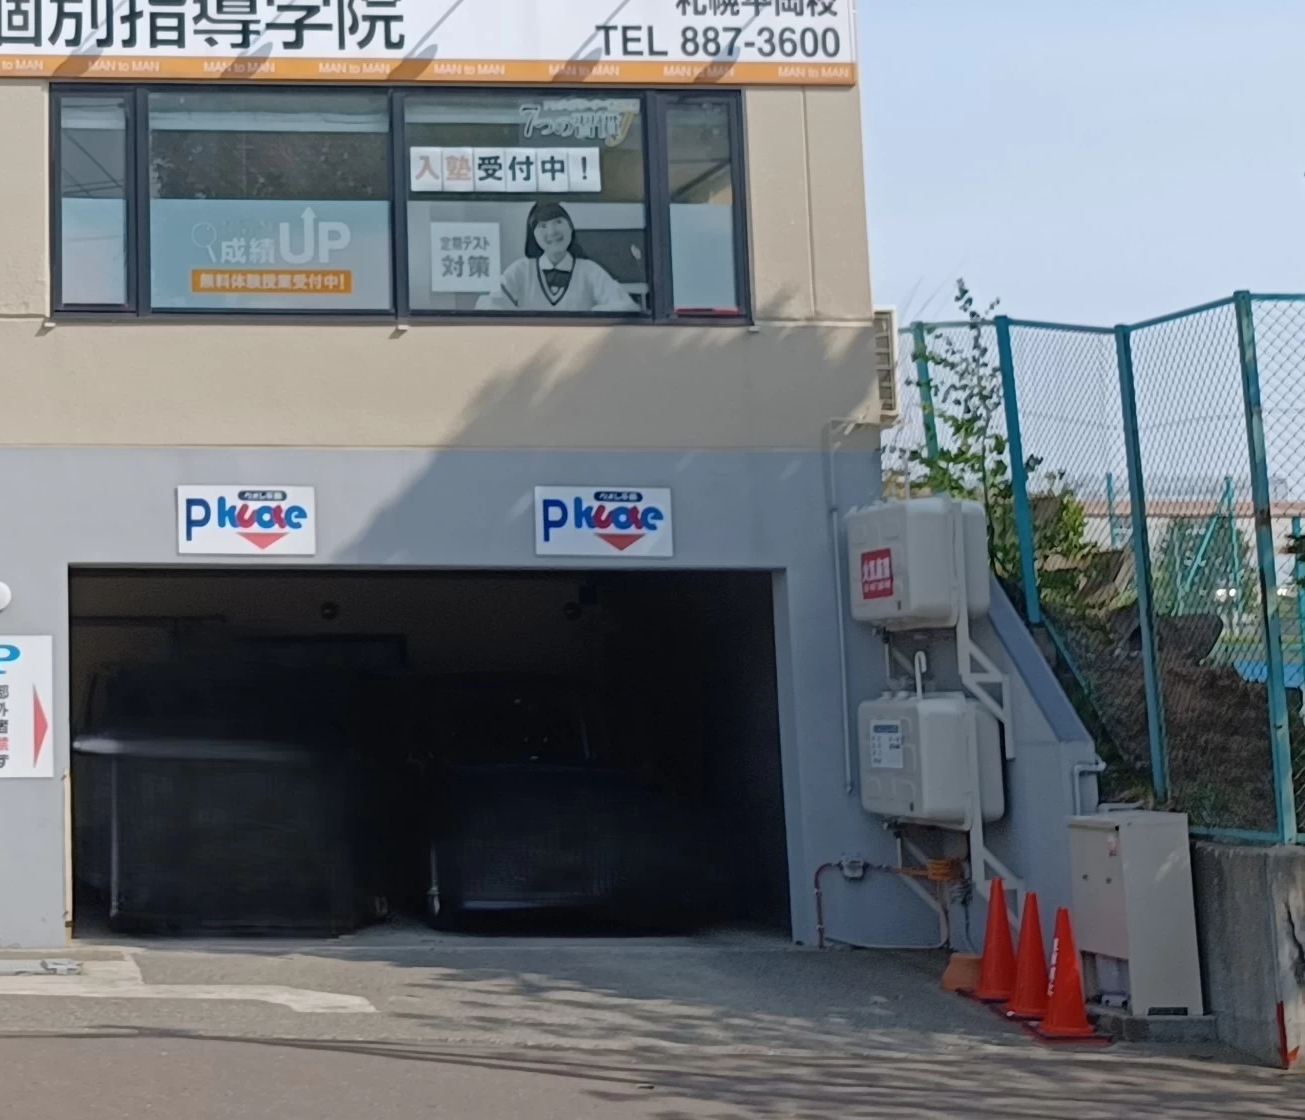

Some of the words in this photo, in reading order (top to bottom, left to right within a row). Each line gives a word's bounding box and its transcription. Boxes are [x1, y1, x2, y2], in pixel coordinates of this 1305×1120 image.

[595, 25, 668, 56] TEL
[680, 26, 840, 58] 887-3600
[16, 59, 43, 70] MAN
[88, 60, 116, 71] MAN
[132, 60, 159, 71] MAN
[204, 61, 231, 73] MAN
[247, 61, 275, 73] MAN
[319, 62, 346, 74] MAN
[363, 62, 390, 74] MAN
[434, 64, 461, 75] MAN
[478, 64, 505, 75] MAN
[549, 64, 576, 76] MAN
[592, 64, 619, 76] MAN
[664, 65, 690, 77] MAN
[707, 65, 734, 77] MAN
[778, 66, 805, 78] MAN
[821, 66, 848, 78] MAN
[441, 254, 490, 278] 対策
[186, 498, 211, 541] P
[543, 499, 568, 542] P
